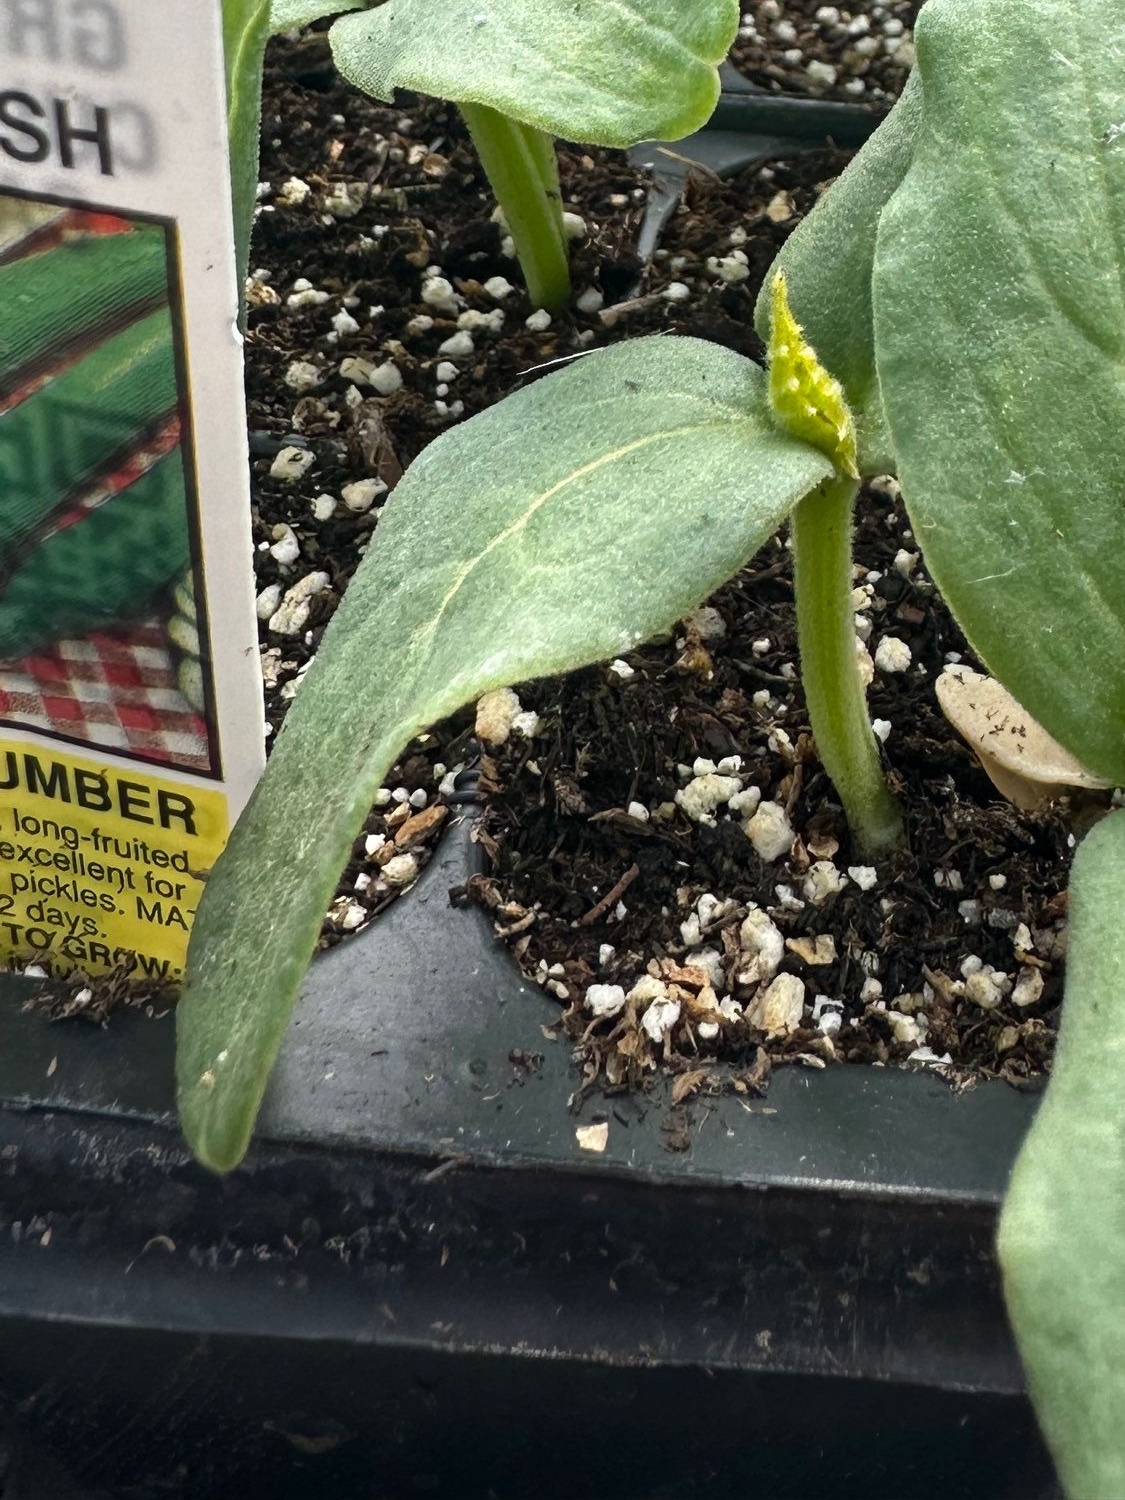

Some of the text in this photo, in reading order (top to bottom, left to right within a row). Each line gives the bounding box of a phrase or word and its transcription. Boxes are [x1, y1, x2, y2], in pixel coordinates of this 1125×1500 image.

[13, 807, 190, 874] long-fruited
[0, 840, 187, 901] excellent for
[10, 869, 126, 916] pickles.
[2, 922, 57, 951] TO
[25, 898, 108, 940] days.
